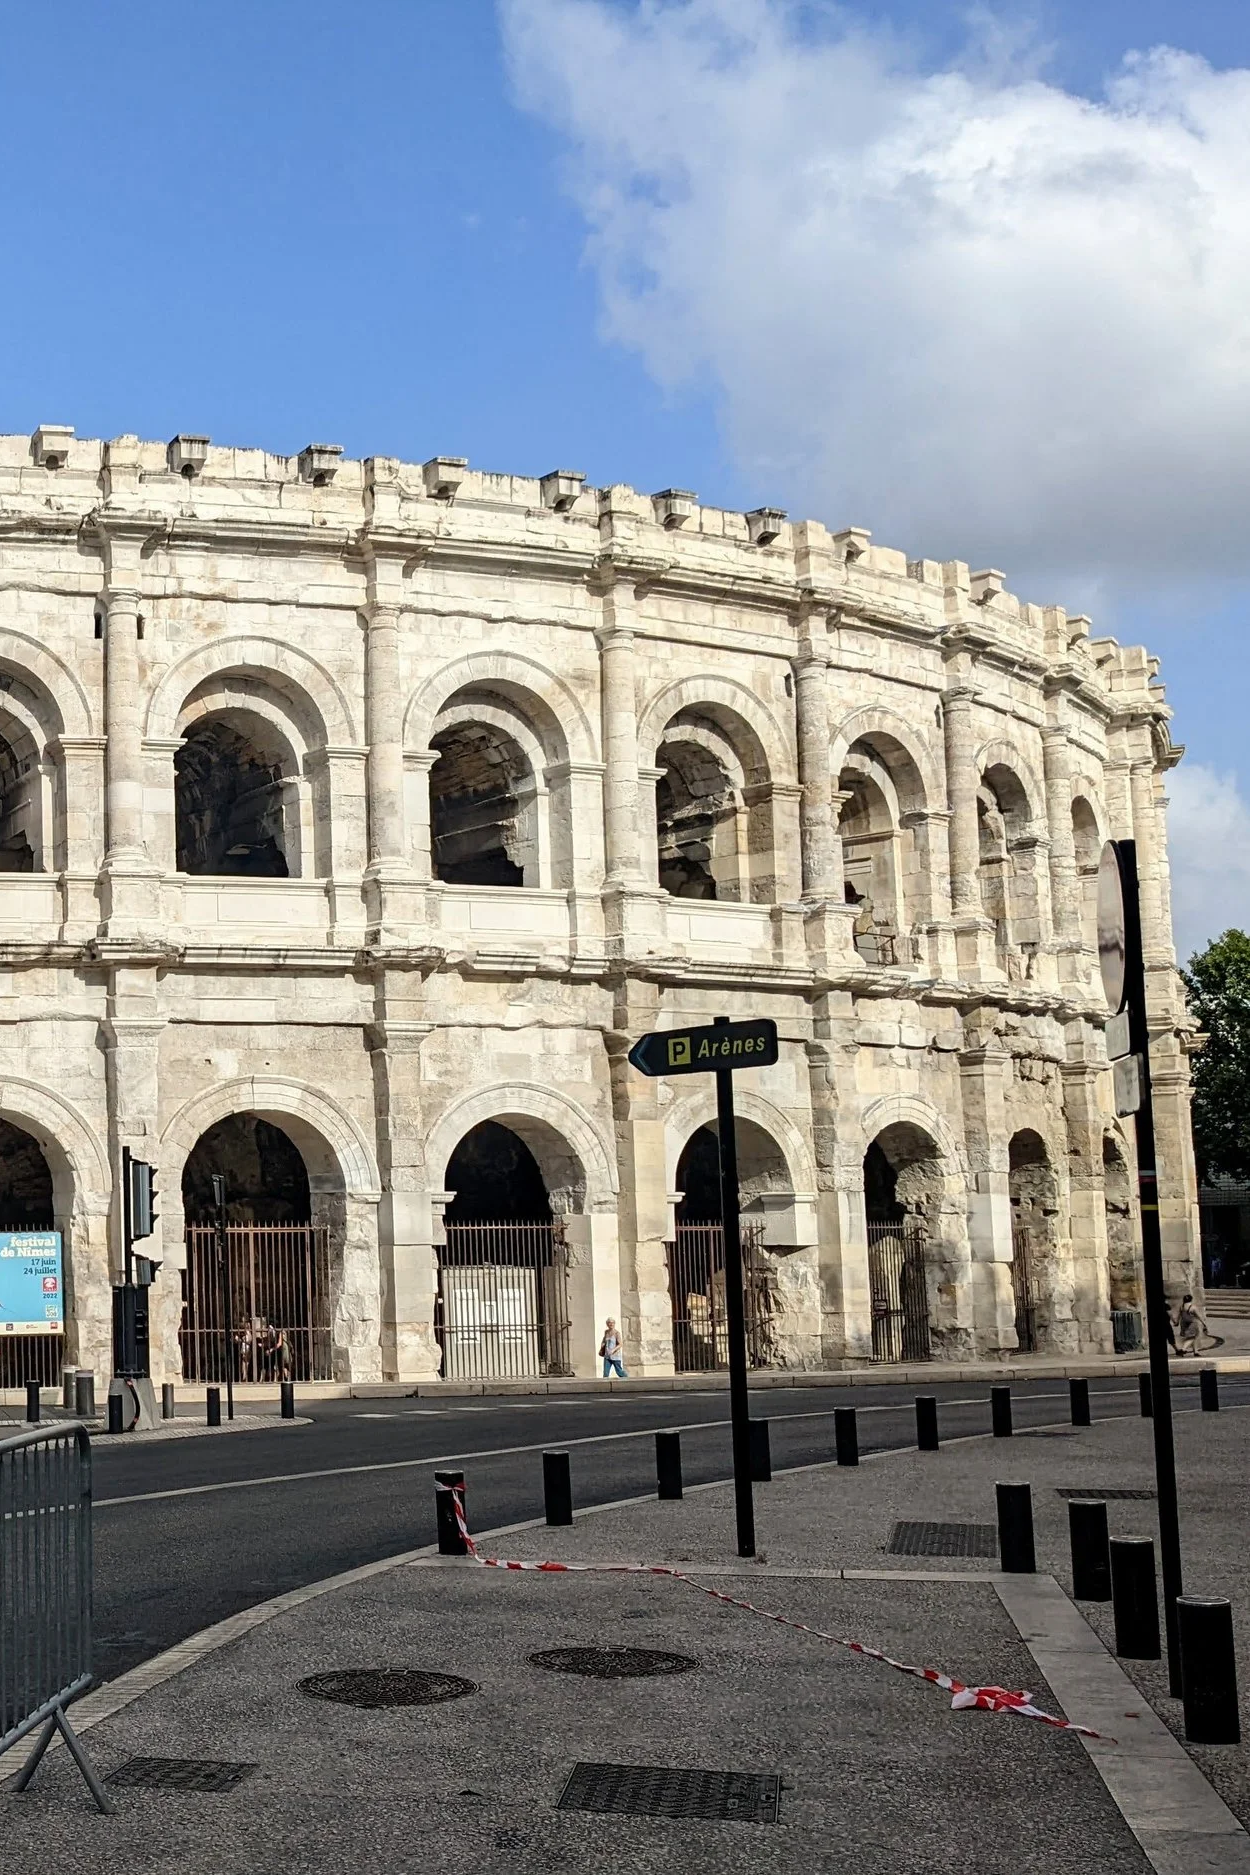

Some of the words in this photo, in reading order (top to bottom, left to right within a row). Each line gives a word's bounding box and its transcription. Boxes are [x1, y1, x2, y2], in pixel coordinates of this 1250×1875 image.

[672, 1041, 686, 1062] P
[697, 1037, 765, 1058] Arènes
[10, 1235, 56, 1247] festival
[0, 1246, 15, 1258] de
[31, 1258, 40, 1266] 17
[41, 1258, 57, 1267] juin
[23, 1267, 33, 1275] 24
[35, 1266, 57, 1276] juillet
